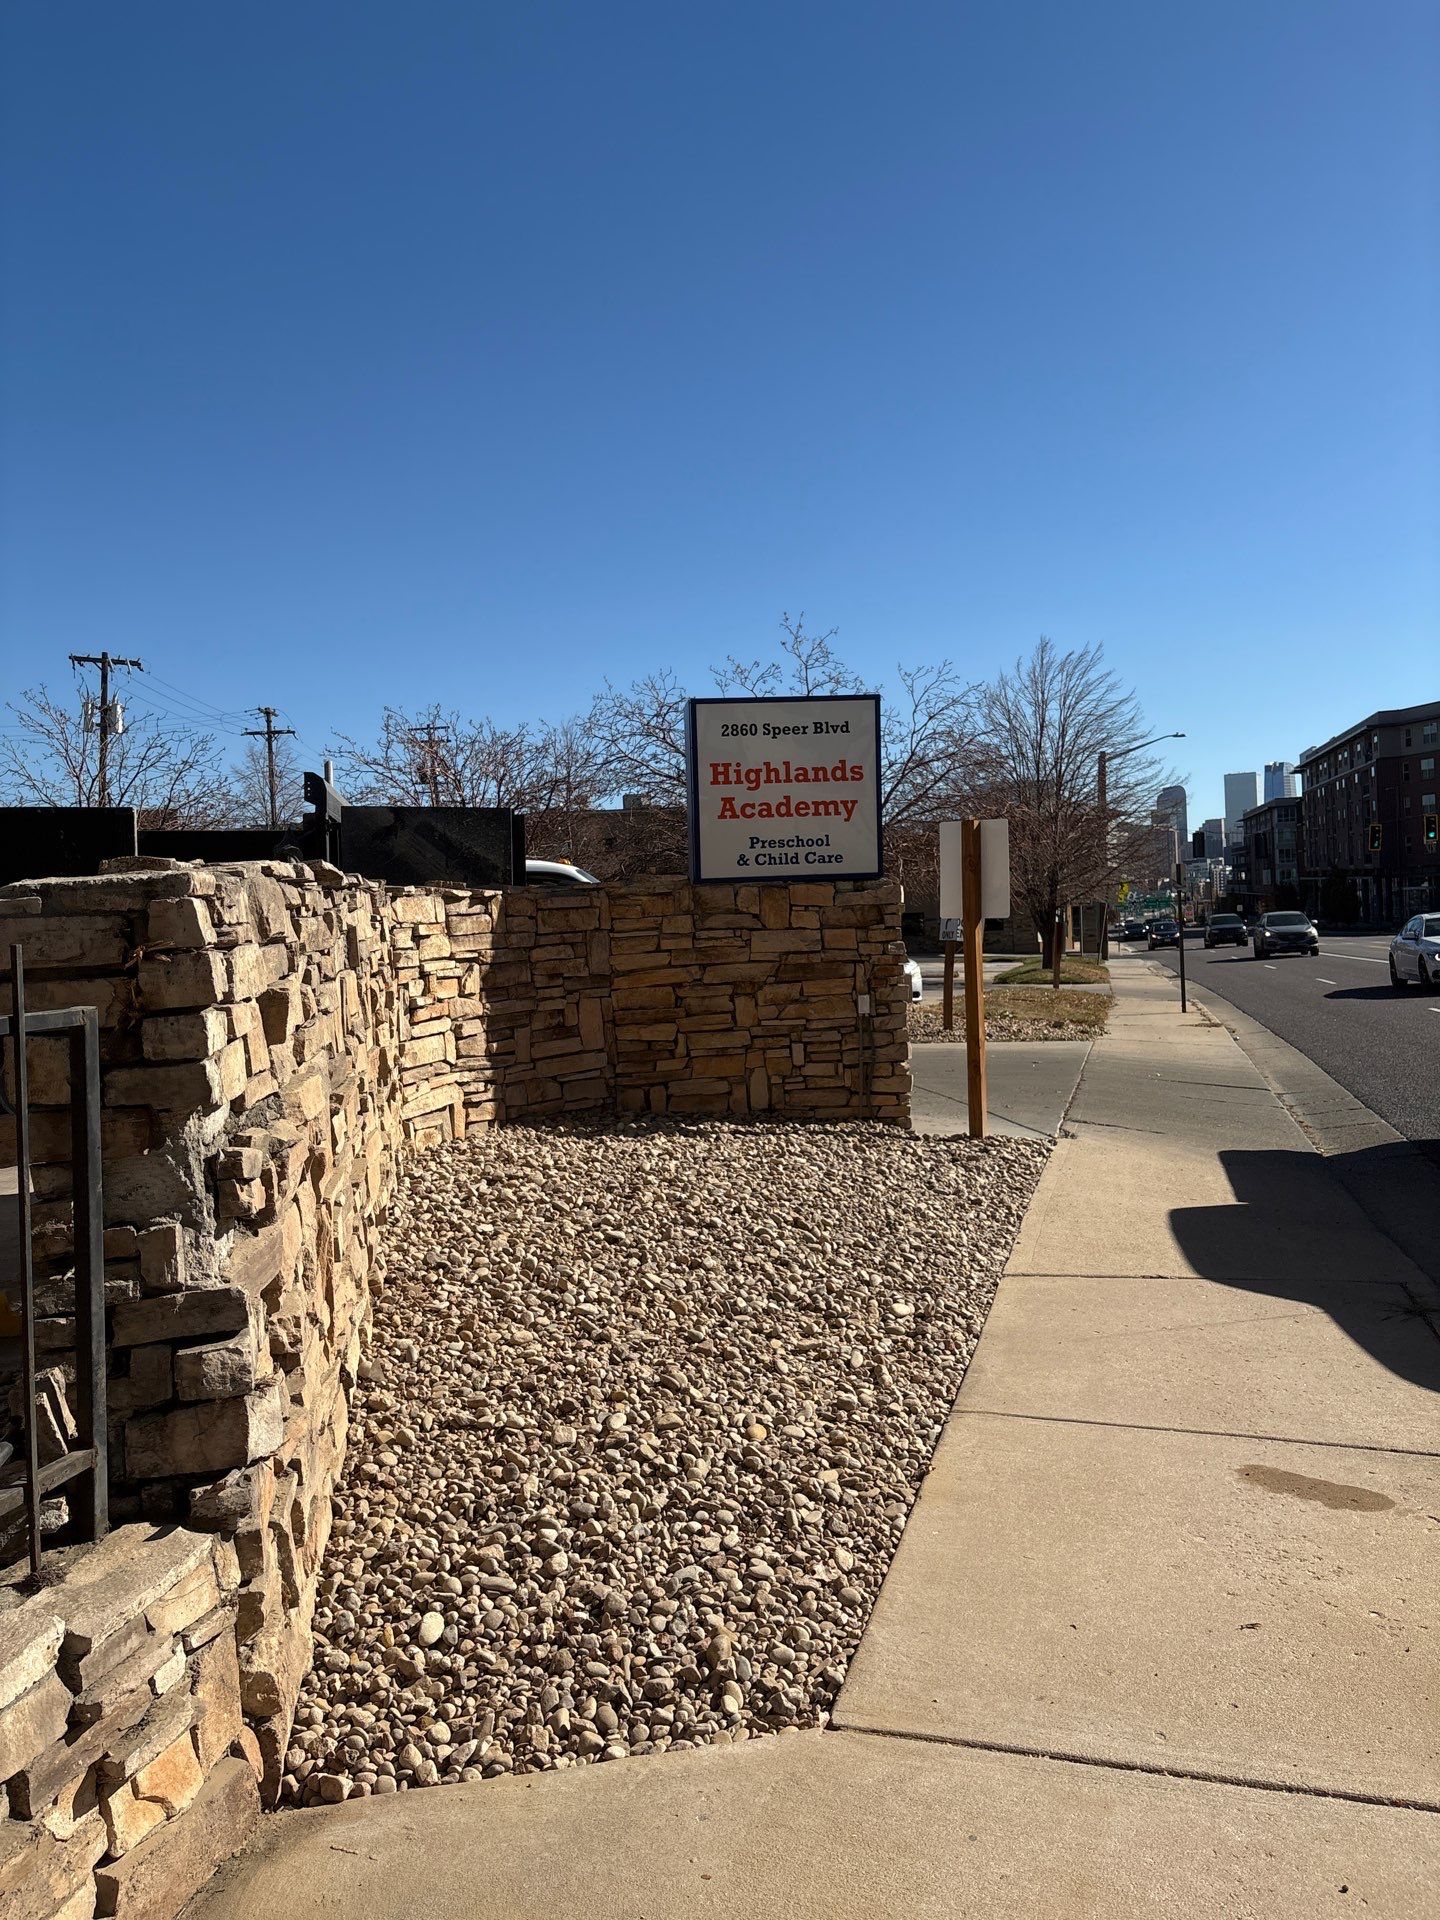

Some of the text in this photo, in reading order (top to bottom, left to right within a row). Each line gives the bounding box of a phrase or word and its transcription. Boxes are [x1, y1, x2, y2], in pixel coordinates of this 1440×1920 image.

[721, 721, 850, 739] 2860 Speer Blvd
[709, 759, 864, 791] Highlands
[717, 795, 858, 822] Academy
[749, 834, 831, 849] Preschool
[736, 851, 844, 866] & Child Care
